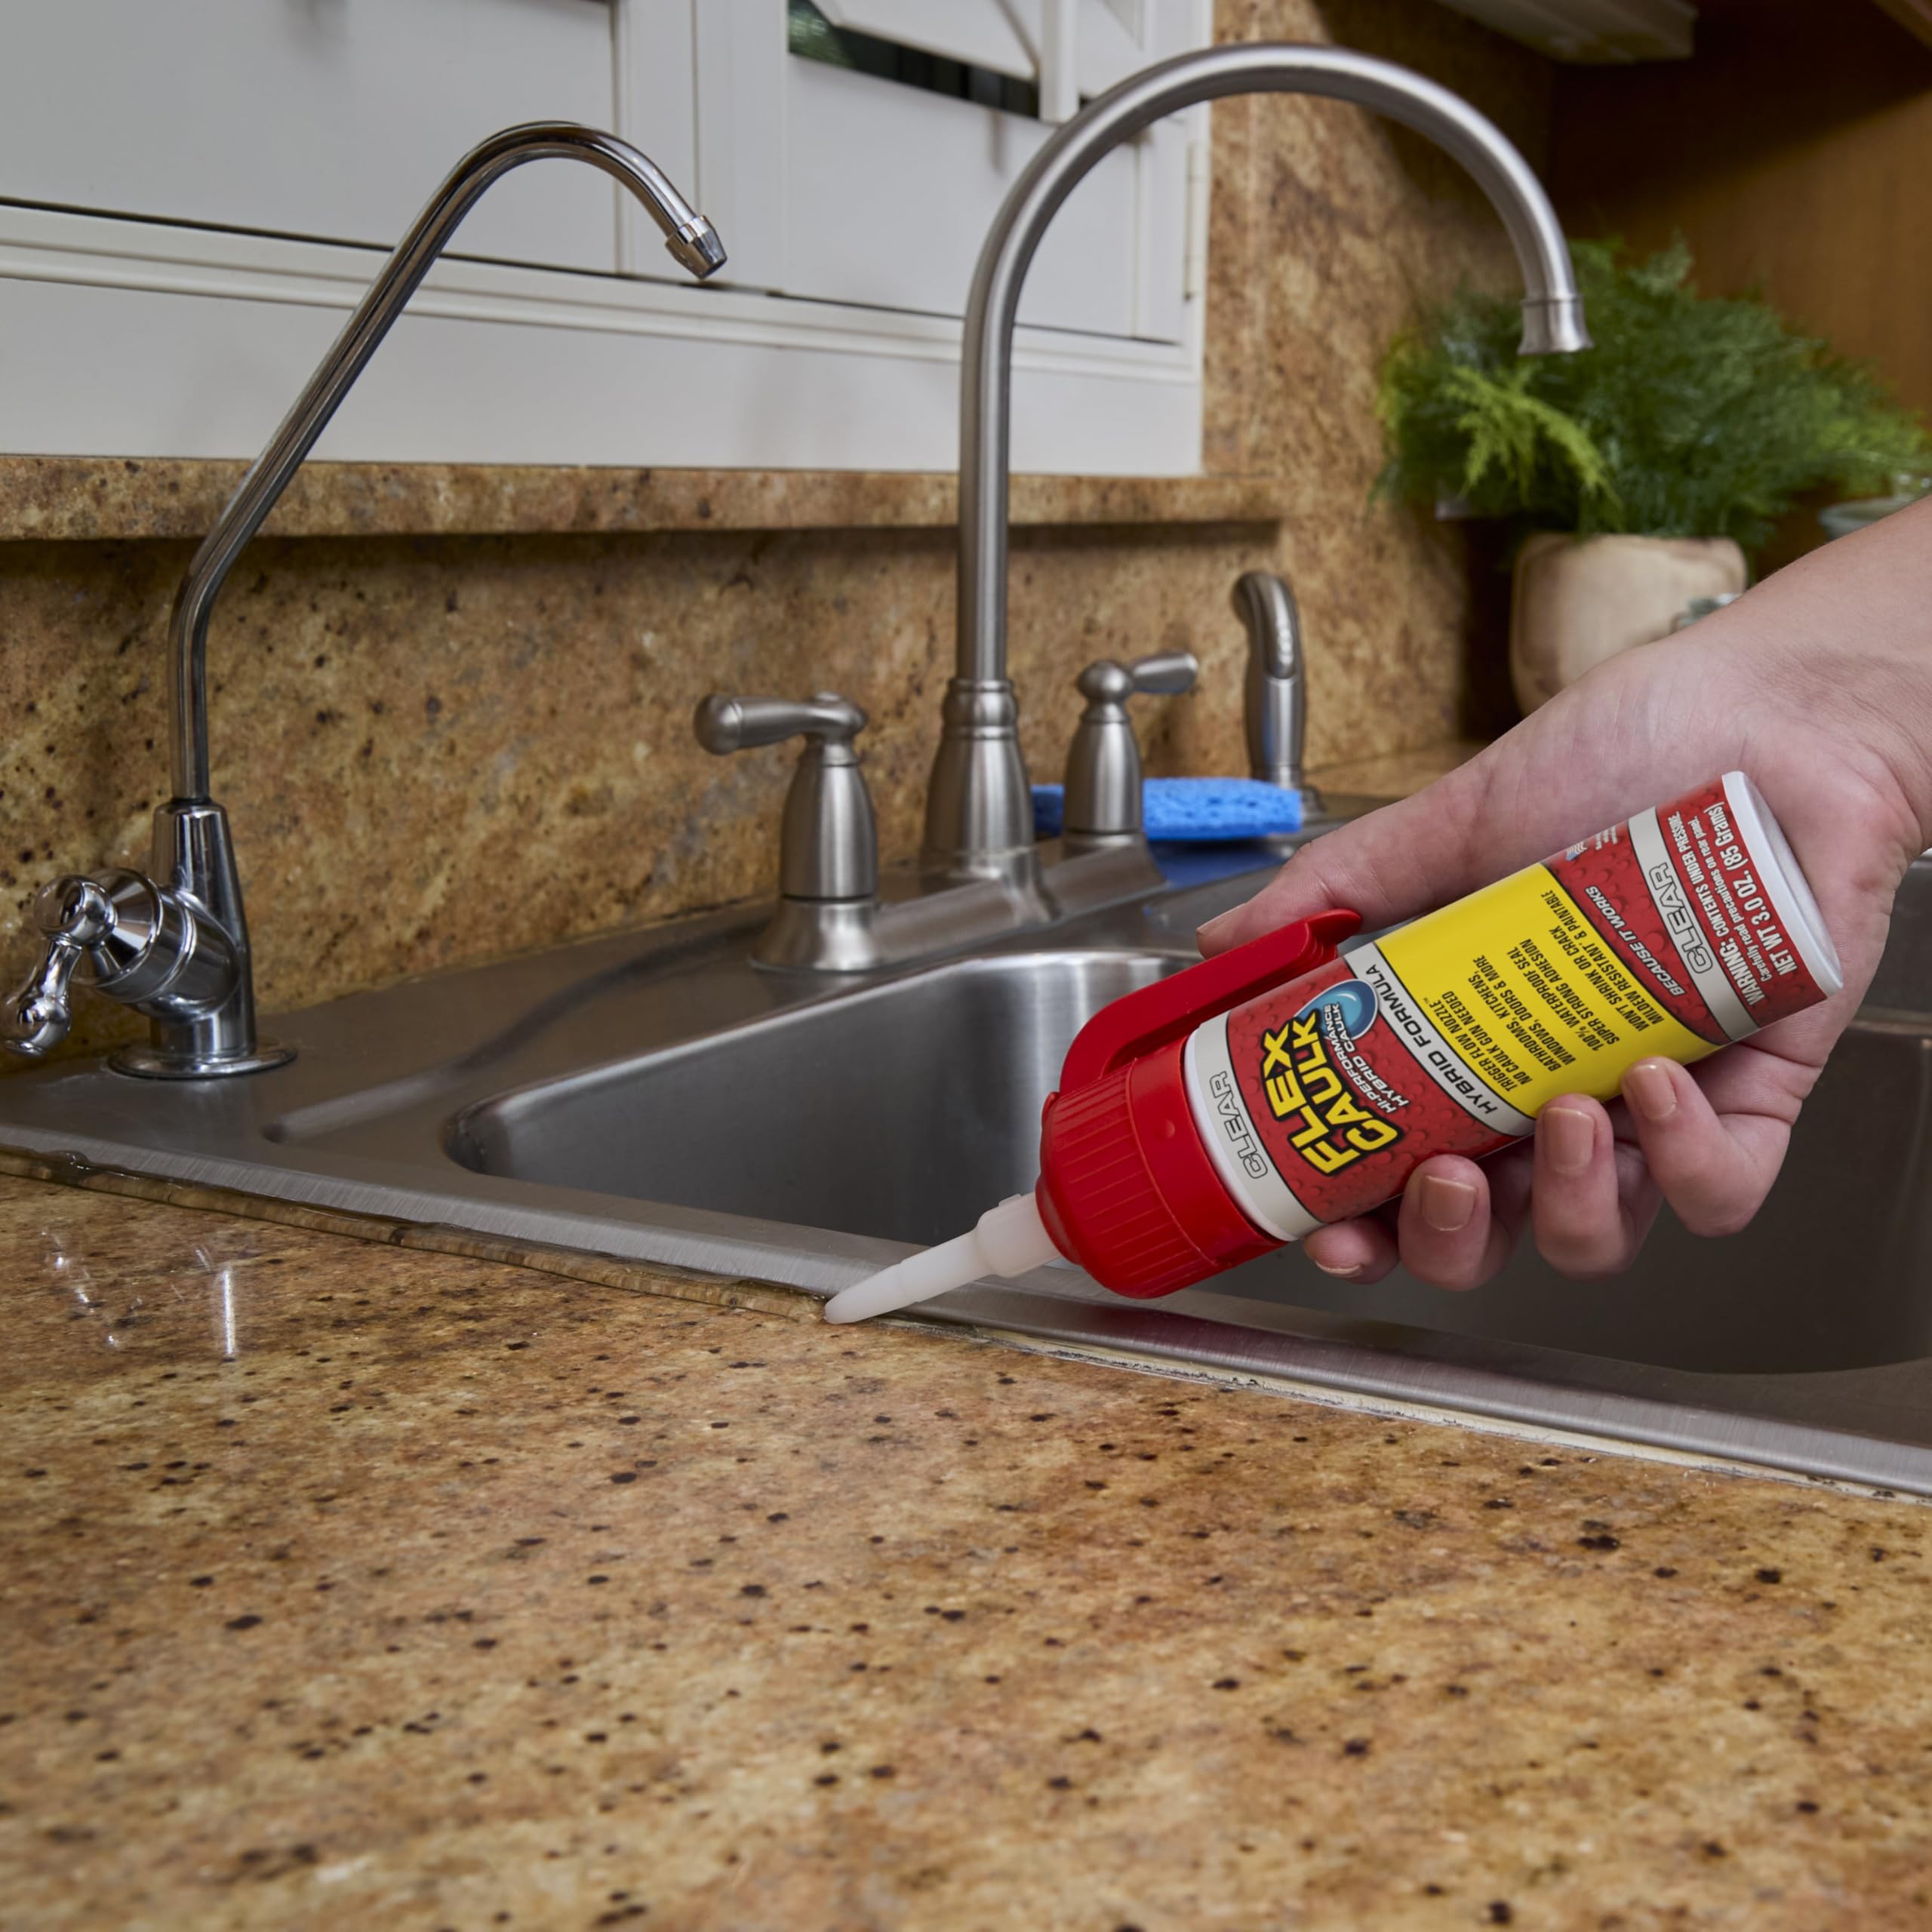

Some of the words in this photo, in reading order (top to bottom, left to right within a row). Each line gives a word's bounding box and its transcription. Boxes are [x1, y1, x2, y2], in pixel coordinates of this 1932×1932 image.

[1666, 811, 1691, 853] PRESSURE.
[1687, 815, 1706, 839] panel.
[1702, 801, 1735, 848] Grams)
[1698, 837, 1712, 856] rear
[1705, 855, 1717, 869] on
[1720, 843, 1749, 872] (85
[1681, 850, 1705, 884] UNDER
[1730, 869, 1758, 899] OZ.
[1540, 889, 1580, 931] PAINTABLE
[1585, 884, 1625, 929] WORKS
[1695, 882, 1729, 937] CONTENTS
[1709, 868, 1744, 924] precautions
[1743, 894, 1771, 926] 3.0
[1648, 862, 1713, 971] CLEAR
[1734, 922, 1753, 946] read
[1548, 924, 1580, 956] CRACK
[1574, 929, 1587, 940] &
[1619, 930, 1635, 941] IT
[1756, 923, 1783, 950] WT
[1472, 954, 1500, 981] MORE
[1506, 946, 1531, 970] SEAL
[1519, 937, 1562, 983] ADHESION
[1573, 955, 1591, 970] OR
[1629, 940, 1685, 996] BECAUSE
[1719, 937, 1764, 1005] WARNING:
[1745, 943, 1772, 982] Carefully
[1768, 946, 1798, 977] NET
[1467, 970, 1510, 1019] KITCHENS,
[1493, 980, 1506, 990] &
[1523, 968, 1580, 1027] WATERPROOF
[1555, 981, 1594, 1019] STRONG
[1585, 968, 1622, 1004] SHRINK
[1365, 963, 1432, 1048] FORMULA
[1441, 989, 1475, 1026] NEEDED
[1500, 989, 1532, 1021] DOORS
[1614, 1002, 1649, 1030] WON'T
[1626, 989, 1664, 1024] MILDEW
[1332, 1002, 1355, 1053] CAULK
[1469, 1023, 1494, 1045] GUN
[1506, 1016, 1561, 1072] BATHROOMS,
[1528, 1018, 1576, 1065] WINDOWS,
[1574, 1024, 1604, 1051] 100%
[1588, 1017, 1620, 1044] SUPER
[1324, 1004, 1396, 1113] HI-PERFORMANCE
[1455, 1032, 1484, 1059] FLOW
[1486, 1044, 1519, 1073] CAULK
[1294, 1011, 1398, 1152] CAULK
[1352, 1054, 1409, 1106] HYBRID
[1427, 1048, 1498, 1114] HYBRID
[1478, 1057, 1518, 1091] TRIGGER
[1512, 1070, 1532, 1084] NO
[1262, 1022, 1360, 1173] FLEX
[1209, 1070, 1269, 1178] CLEAR
